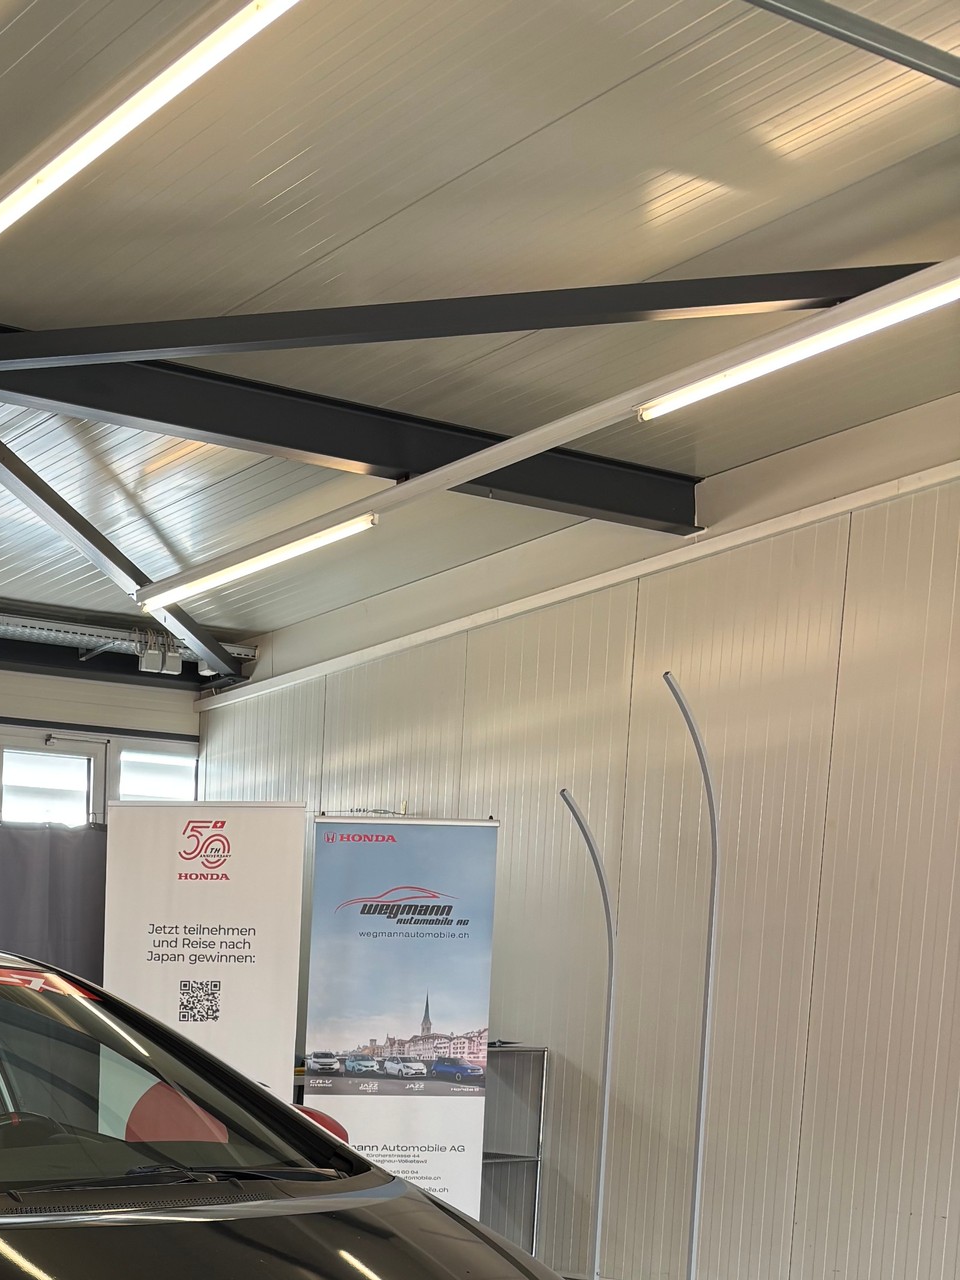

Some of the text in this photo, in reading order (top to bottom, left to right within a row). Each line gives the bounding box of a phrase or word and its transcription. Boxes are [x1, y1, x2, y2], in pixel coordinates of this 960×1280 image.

[339, 833, 397, 843] HONDA
[177, 872, 231, 881] HONDA
[359, 903, 454, 919] wegmann
[148, 923, 256, 936] Jetzt teilnehmen
[358, 930, 470, 939] wegmannautomobile.ch
[152, 938, 251, 950] und Reise nach
[146, 951, 256, 965] Japan gewinnen:
[381, 1144, 447, 1152] Automobile
[449, 1145, 465, 1153] AG
